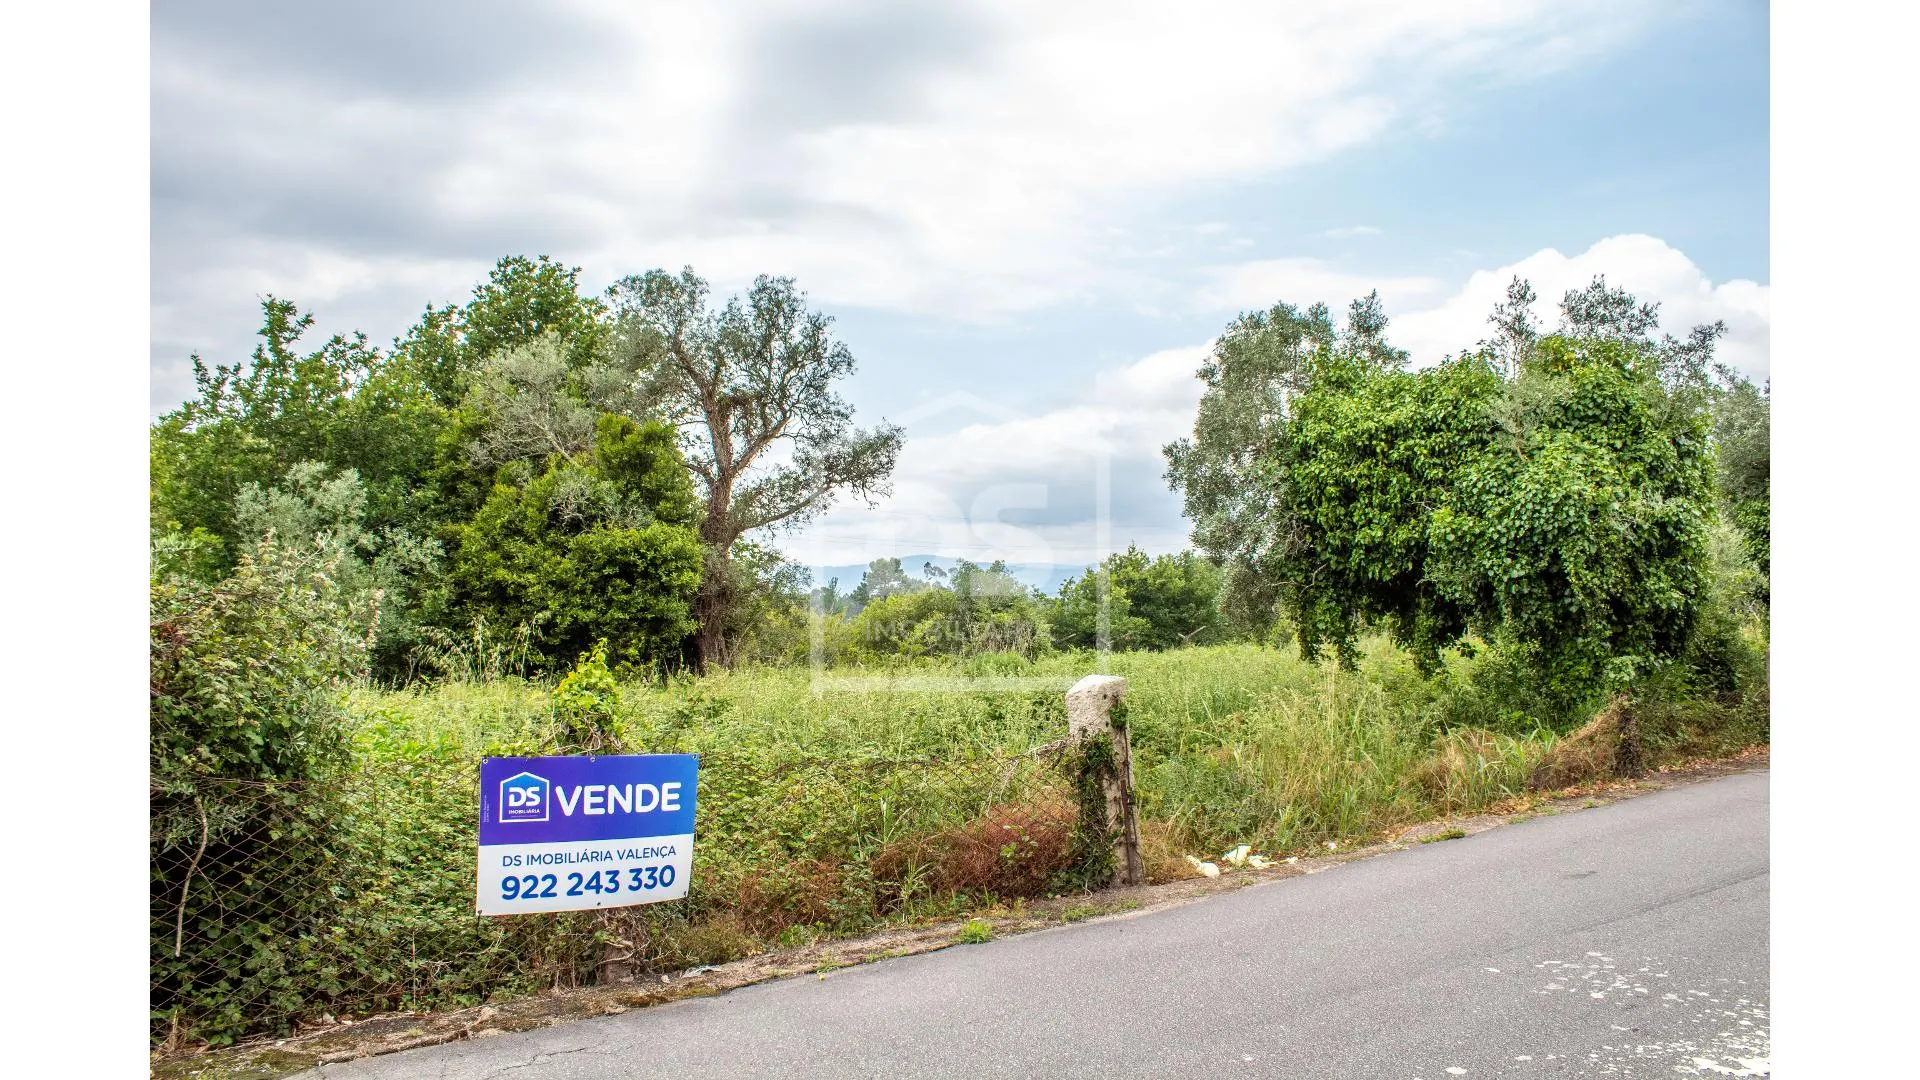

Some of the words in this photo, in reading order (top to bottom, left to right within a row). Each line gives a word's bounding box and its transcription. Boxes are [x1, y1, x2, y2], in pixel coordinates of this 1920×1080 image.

[508, 786, 541, 807] DS
[555, 782, 681, 816] VENDE
[502, 855, 522, 867] DS
[526, 849, 613, 866] IMOBILIÁRIA
[617, 845, 676, 860] VALENÇA
[501, 874, 558, 901] 922
[566, 870, 620, 897] 243
[628, 865, 676, 891] 330
